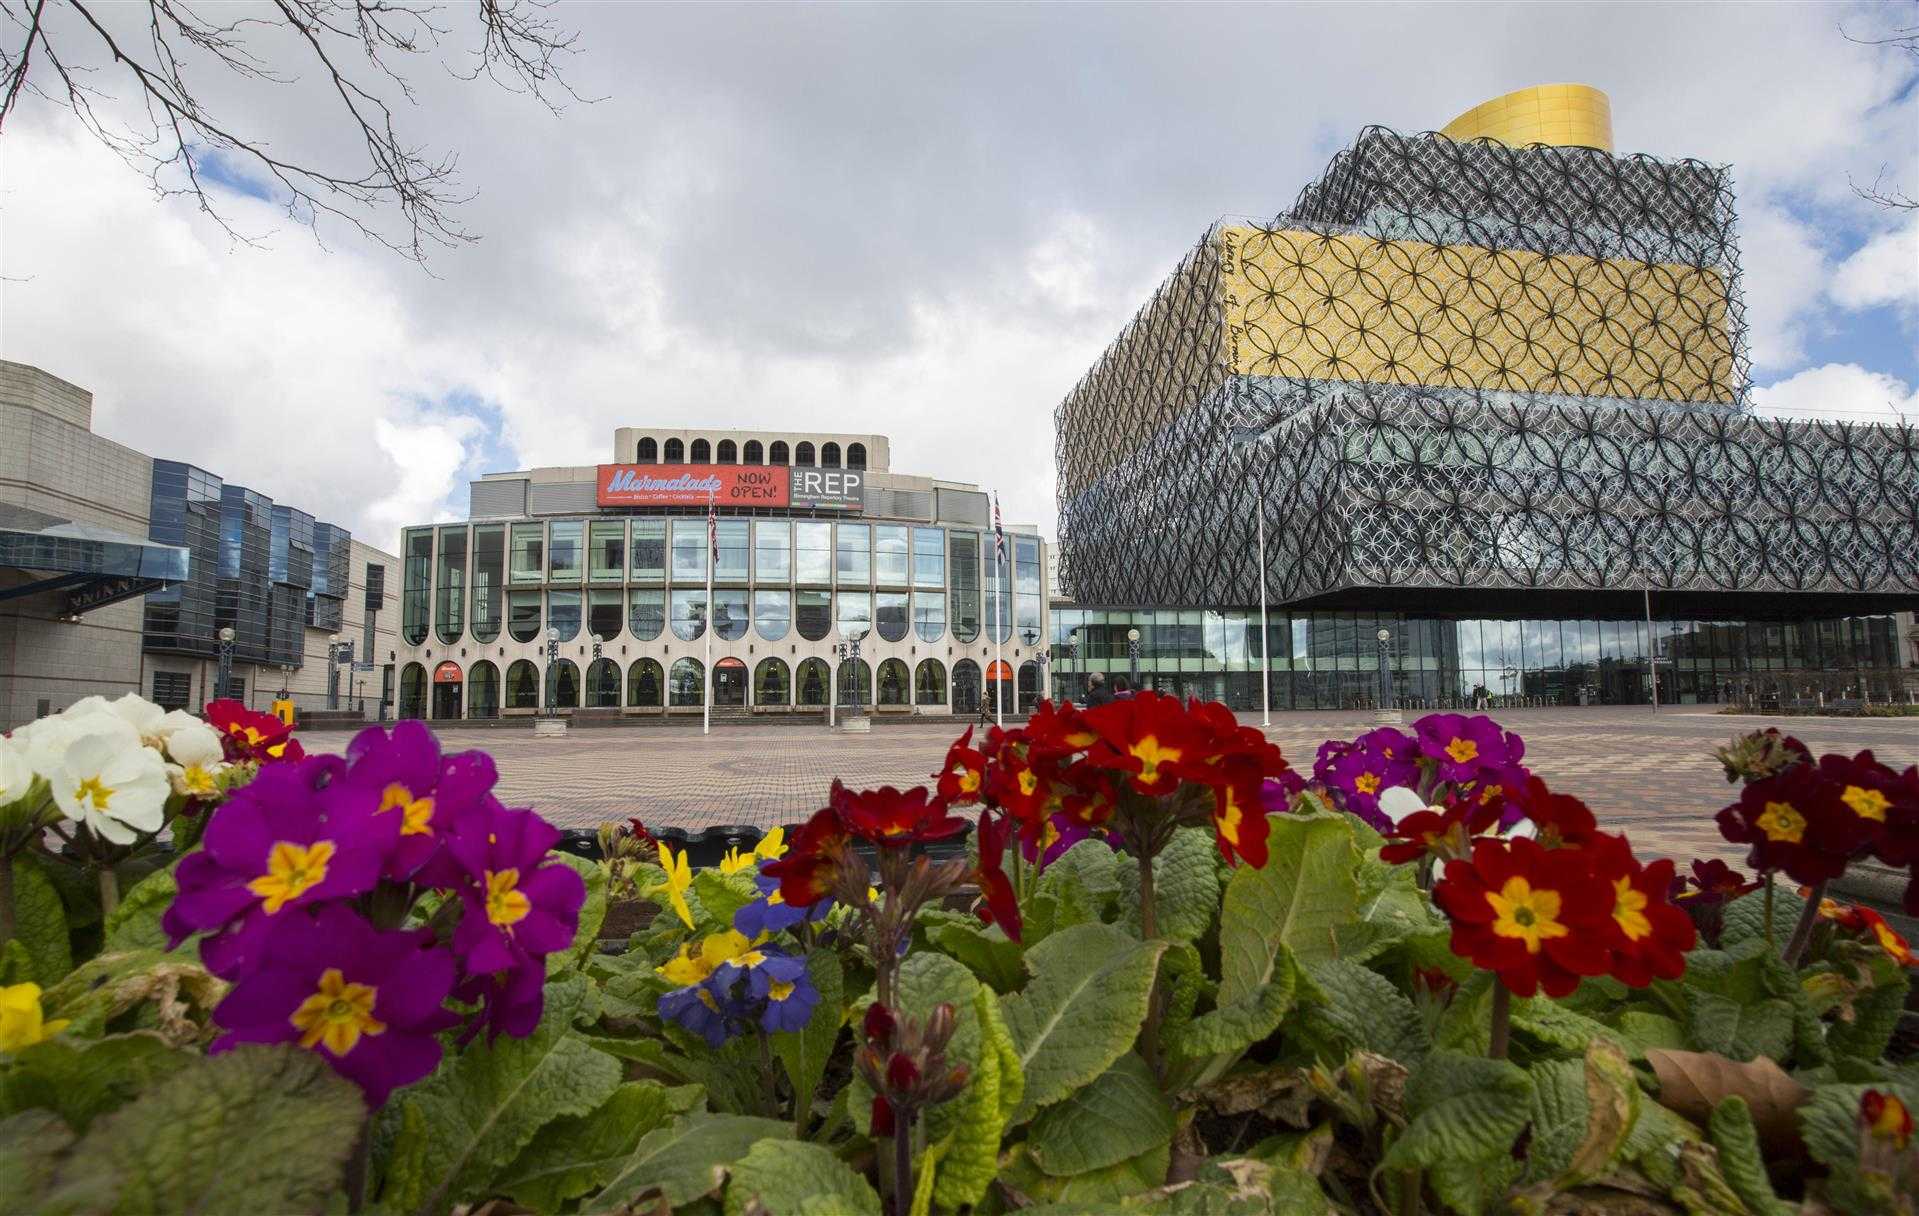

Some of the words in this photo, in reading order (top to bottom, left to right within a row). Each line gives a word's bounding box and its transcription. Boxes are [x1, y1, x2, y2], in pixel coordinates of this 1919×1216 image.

[1224, 294, 1240, 310] of
[608, 469, 722, 492] Marmalade
[738, 472, 771, 484] NOW
[793, 471, 803, 491] THE
[804, 472, 860, 495] REP
[731, 486, 777, 498] OPEN!
